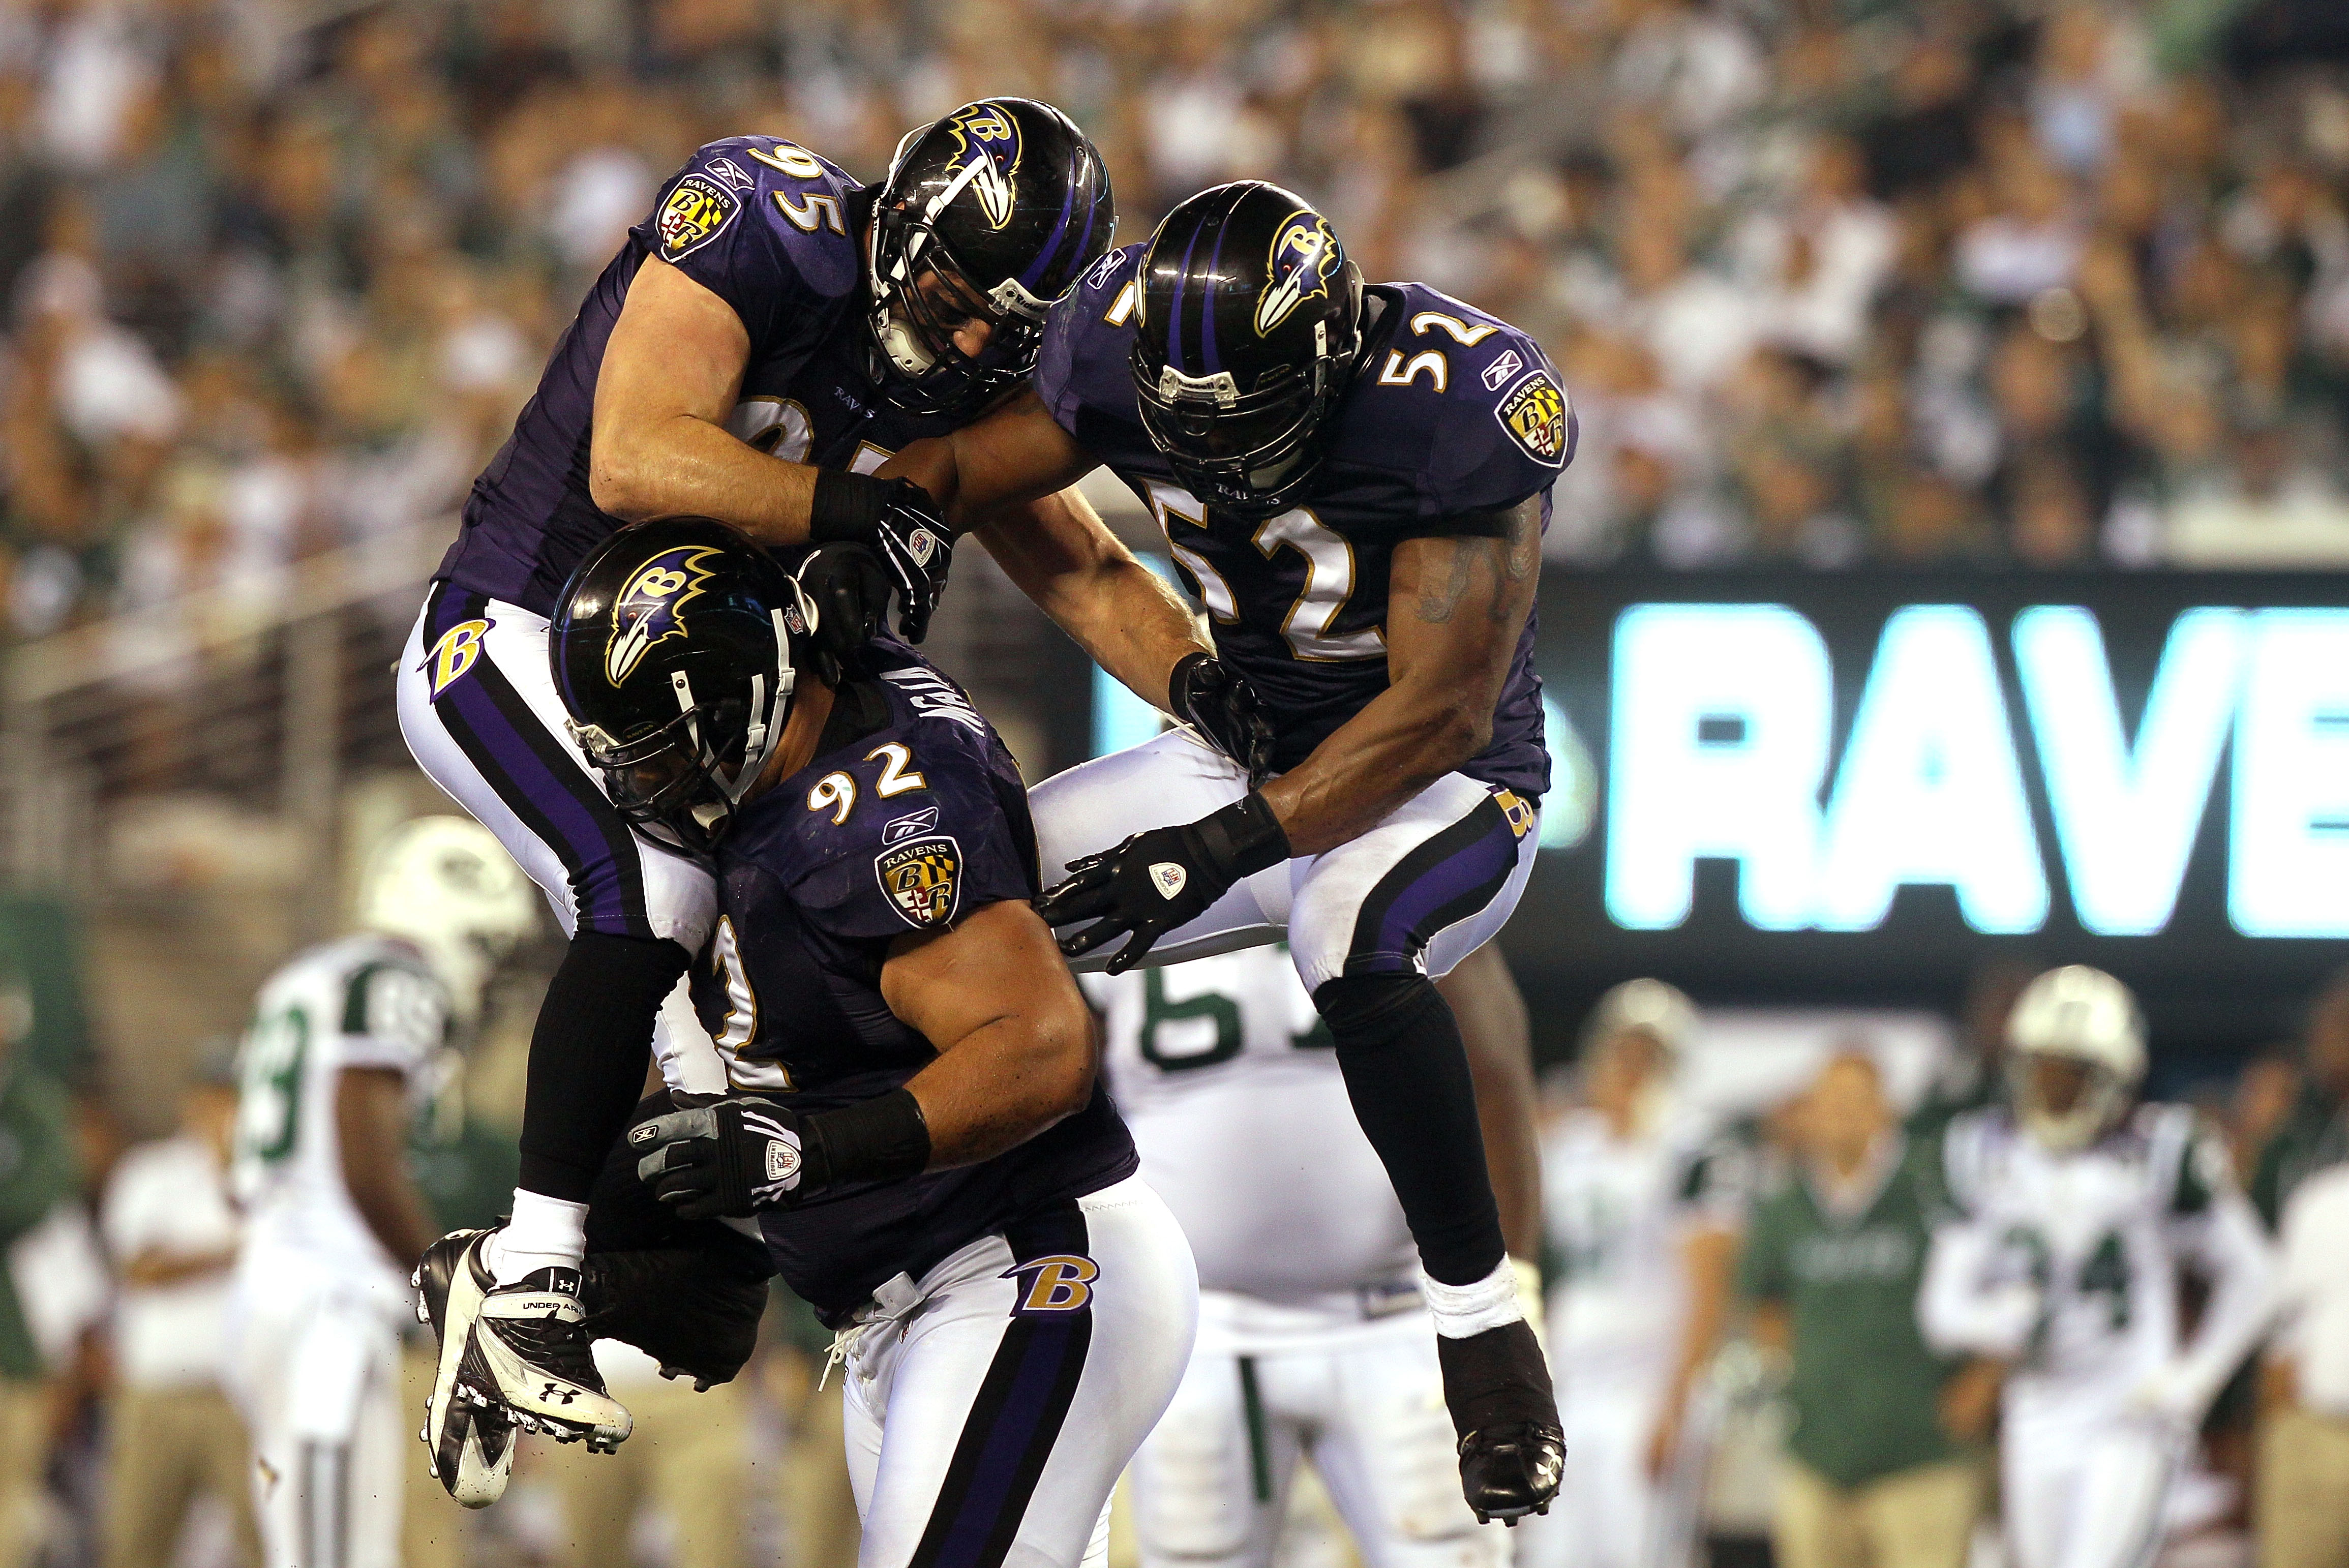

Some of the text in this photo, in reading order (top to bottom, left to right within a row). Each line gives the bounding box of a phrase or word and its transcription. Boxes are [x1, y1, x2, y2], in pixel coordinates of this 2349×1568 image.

[684, 179, 731, 208] RAVENS
[746, 145, 846, 236] 95
[1376, 311, 1498, 394] 52
[1503, 377, 1546, 416] RAVENS
[1137, 475, 1388, 662] 52
[807, 742, 926, 826] 92
[884, 844, 948, 868] RAVENS
[1168, 868, 1180, 883] NFL
[784, 1153, 794, 1168] NFL
